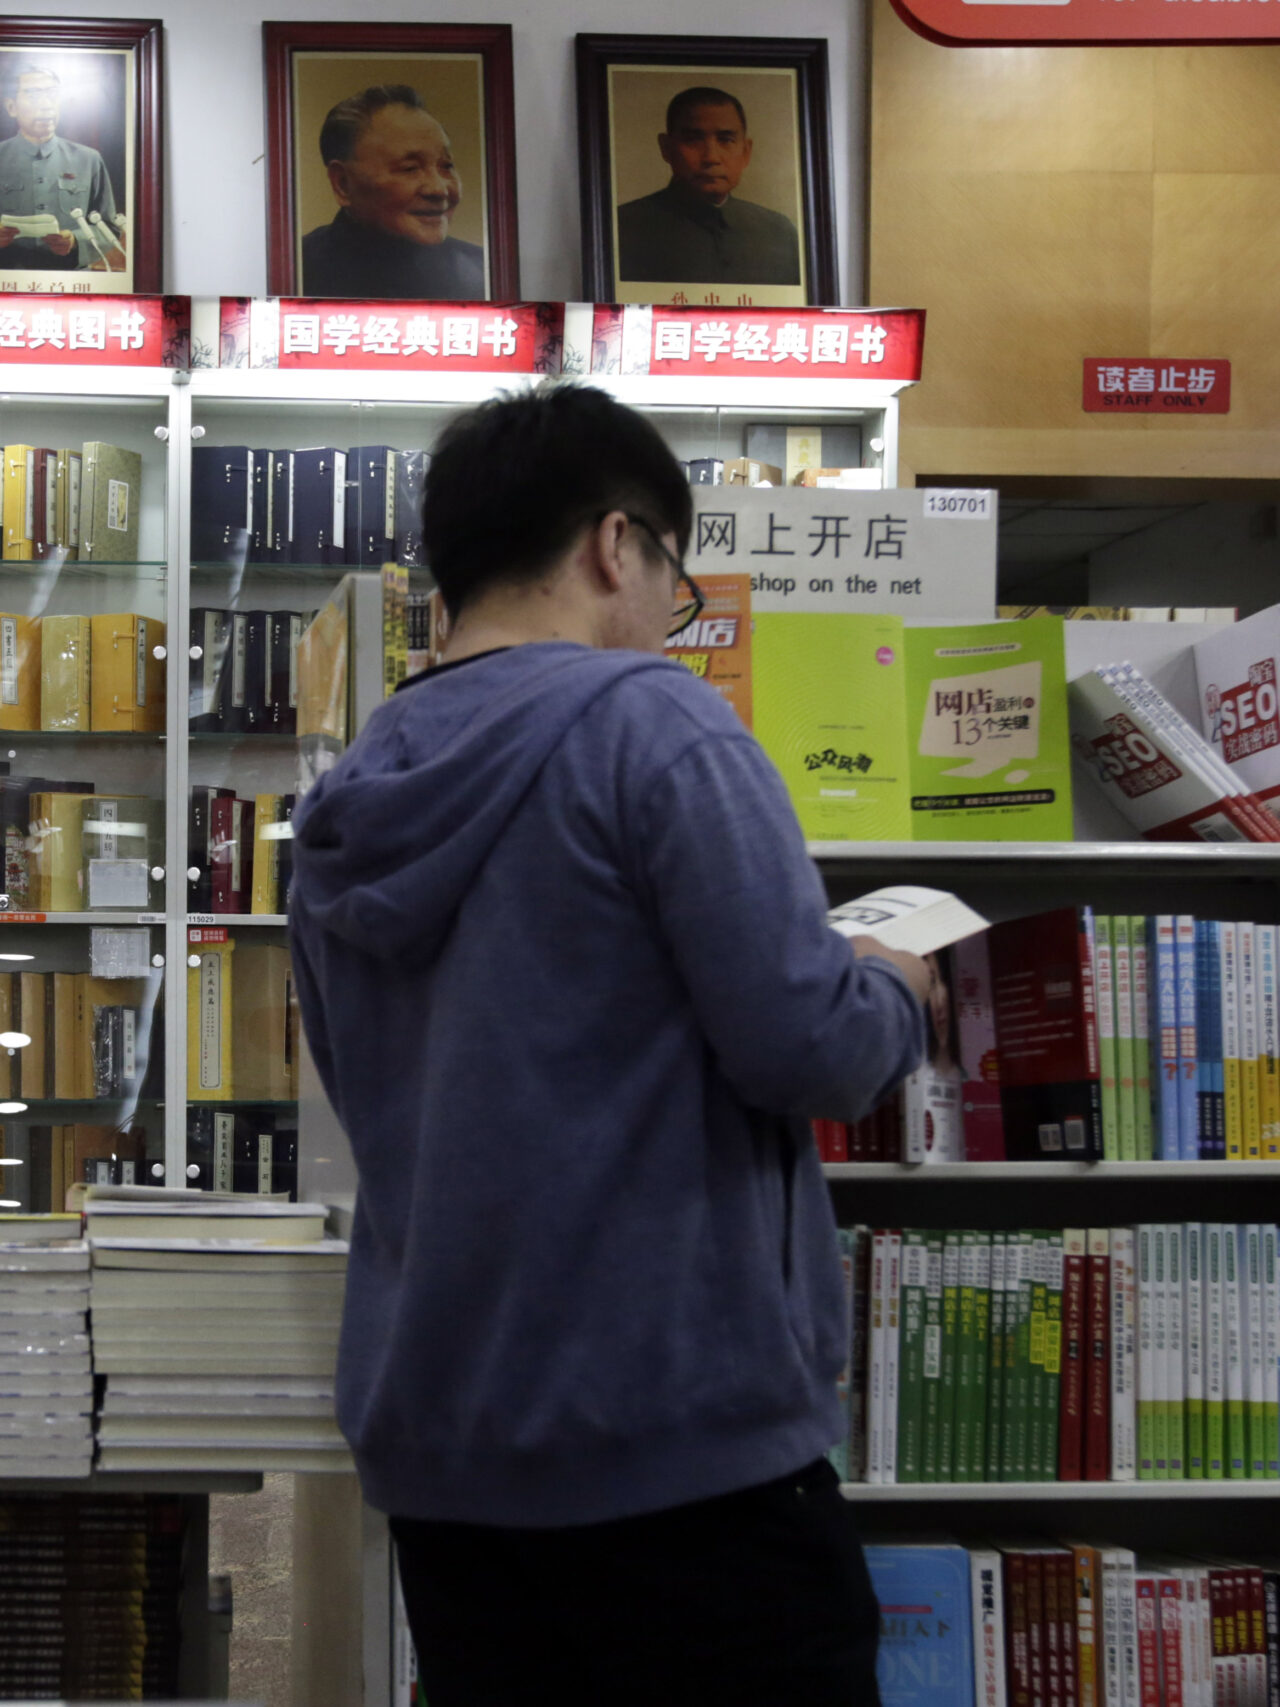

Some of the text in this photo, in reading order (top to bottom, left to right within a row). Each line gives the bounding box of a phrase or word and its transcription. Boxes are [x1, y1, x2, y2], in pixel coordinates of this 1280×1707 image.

[282, 313, 518, 357] 国学经典图书
[654, 320, 887, 364] 国学经典图书
[1097, 366, 1216, 394] 读者止步
[1103, 395, 1206, 407] STAFF ONLY
[928, 497, 986, 513] 130701
[696, 511, 908, 560] 网上开店
[809, 577, 834, 593] on
[846, 574, 878, 594] the
[890, 576, 922, 595] net
[1221, 682, 1277, 737] SEO
[1097, 732, 1159, 777] SEO
[188, 915, 214, 923] 115029
